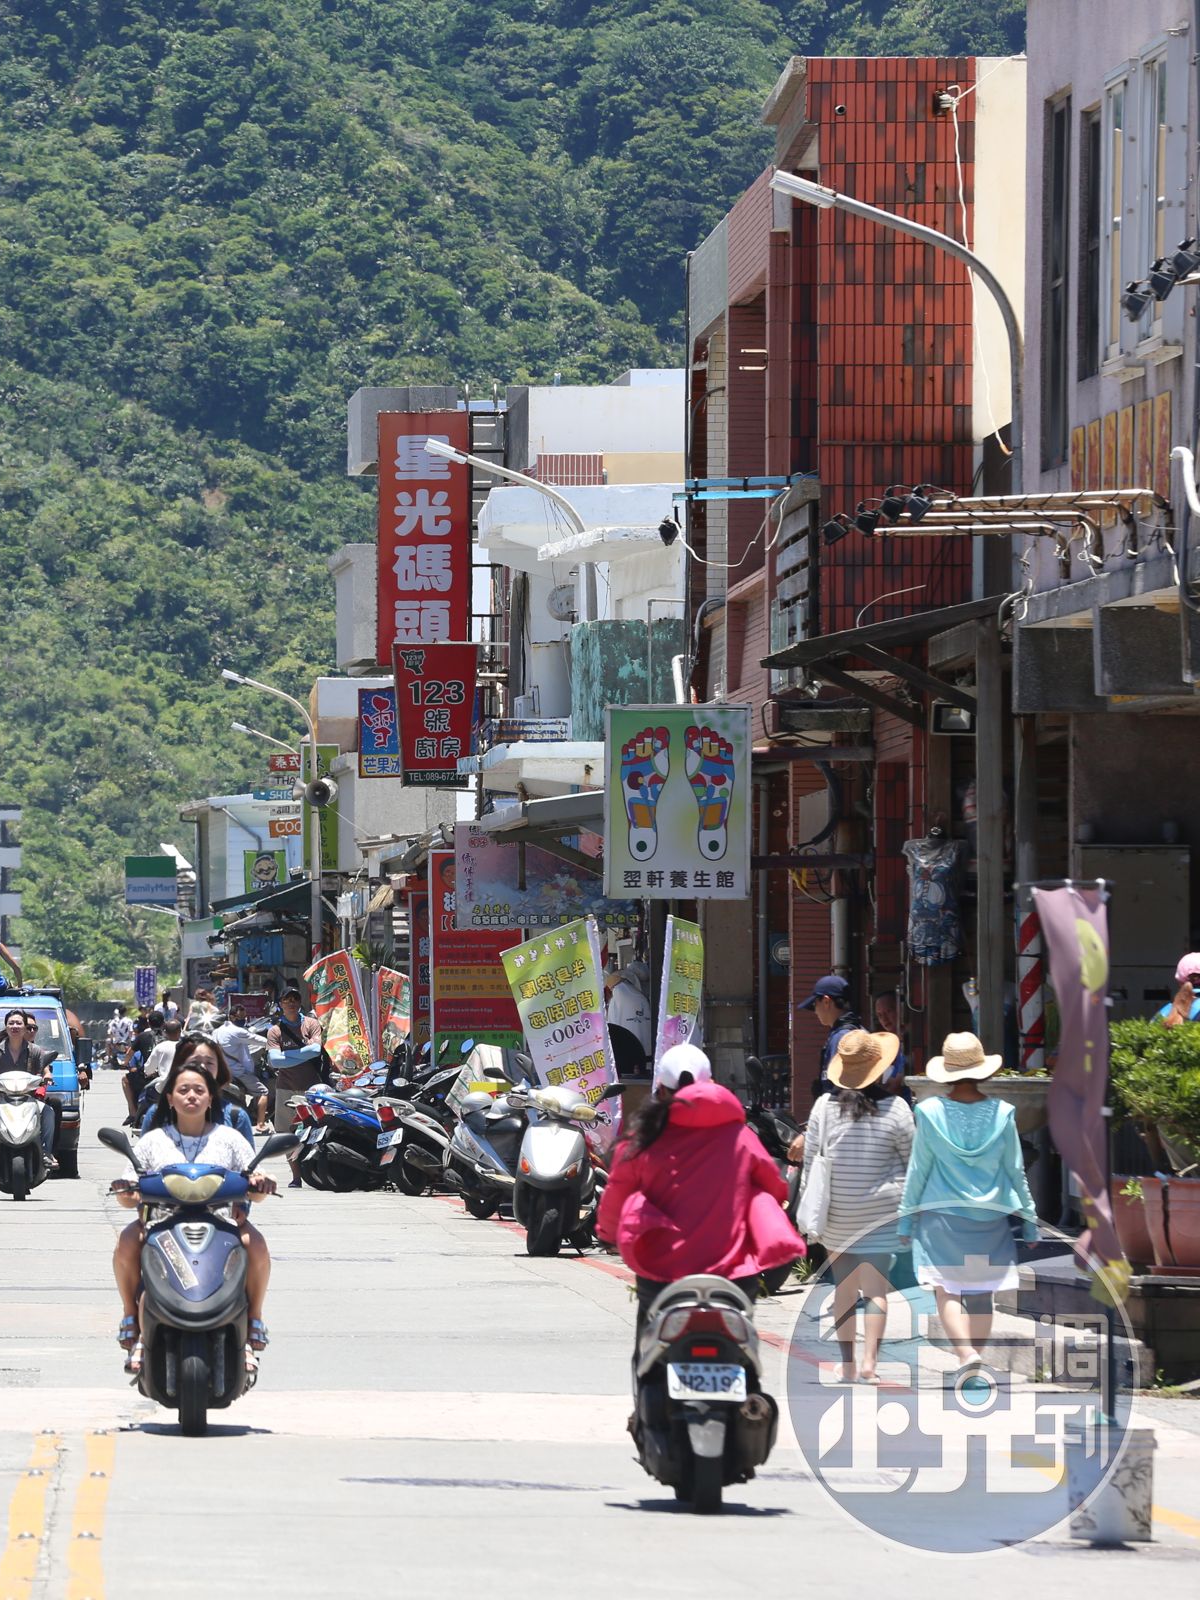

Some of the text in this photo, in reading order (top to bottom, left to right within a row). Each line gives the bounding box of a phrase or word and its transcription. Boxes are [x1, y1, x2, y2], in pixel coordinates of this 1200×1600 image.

[392, 435, 453, 643] 星光碼頭
[408, 680, 465, 705] 123
[424, 708, 451, 732] 號
[415, 736, 462, 759] 廚房
[127, 882, 176, 893] FamilyMart
